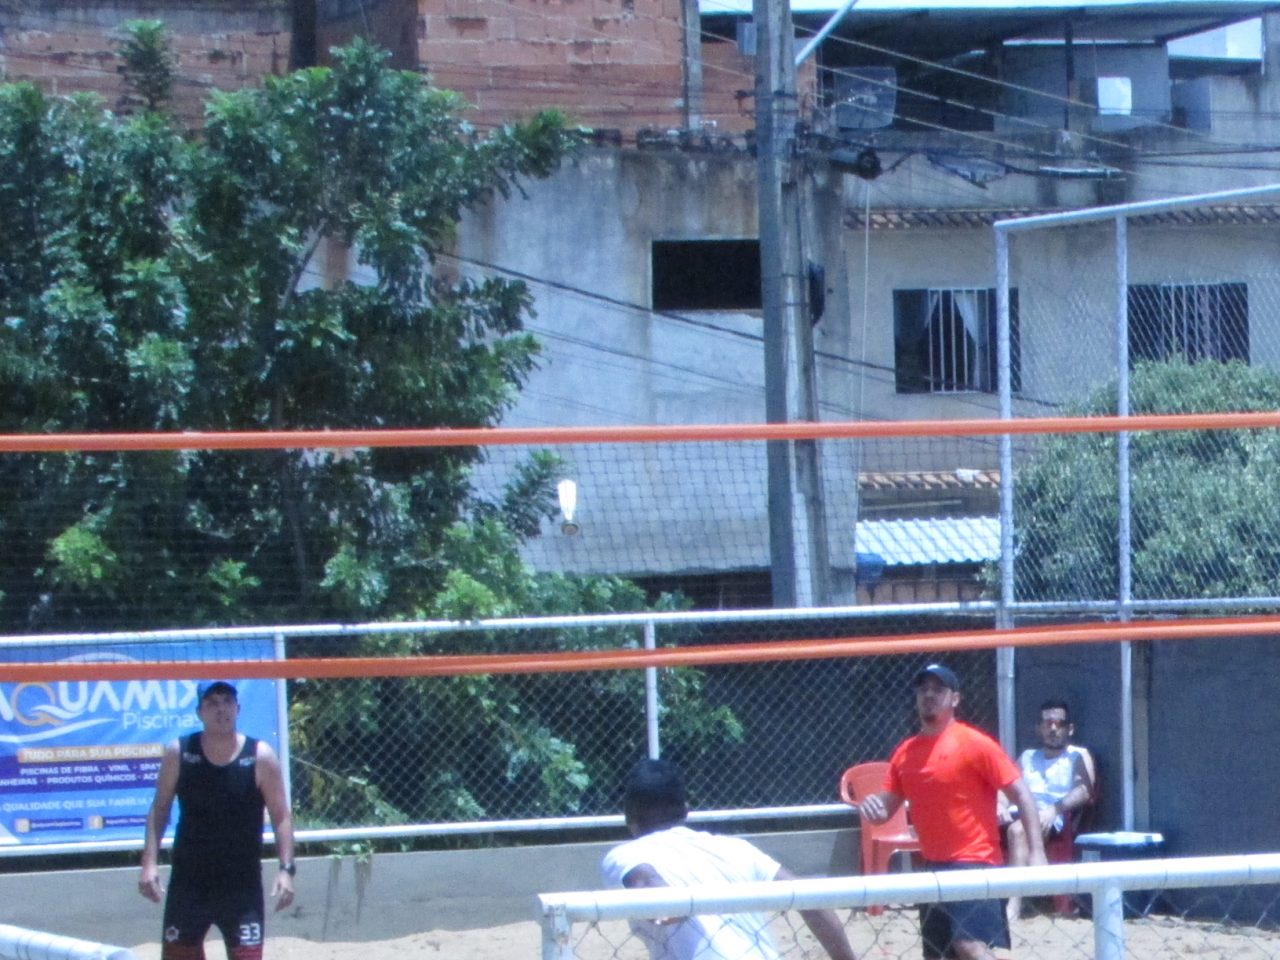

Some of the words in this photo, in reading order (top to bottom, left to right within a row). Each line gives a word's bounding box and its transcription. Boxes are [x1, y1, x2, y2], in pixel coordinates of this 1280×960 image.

[23, 749, 54, 760] TUDO
[56, 748, 87, 759] PARA
[90, 747, 111, 757] SUA
[20, 766, 59, 775] PISCINAS
[61, 765, 72, 774] DE
[74, 764, 100, 773] FIBRA
[109, 763, 130, 772] VINIL
[47, 775, 93, 785] PRODUTOS
[2, 802, 60, 813] QUALIDADE
[63, 801, 84, 810] QUE
[239, 922, 261, 940] 33
